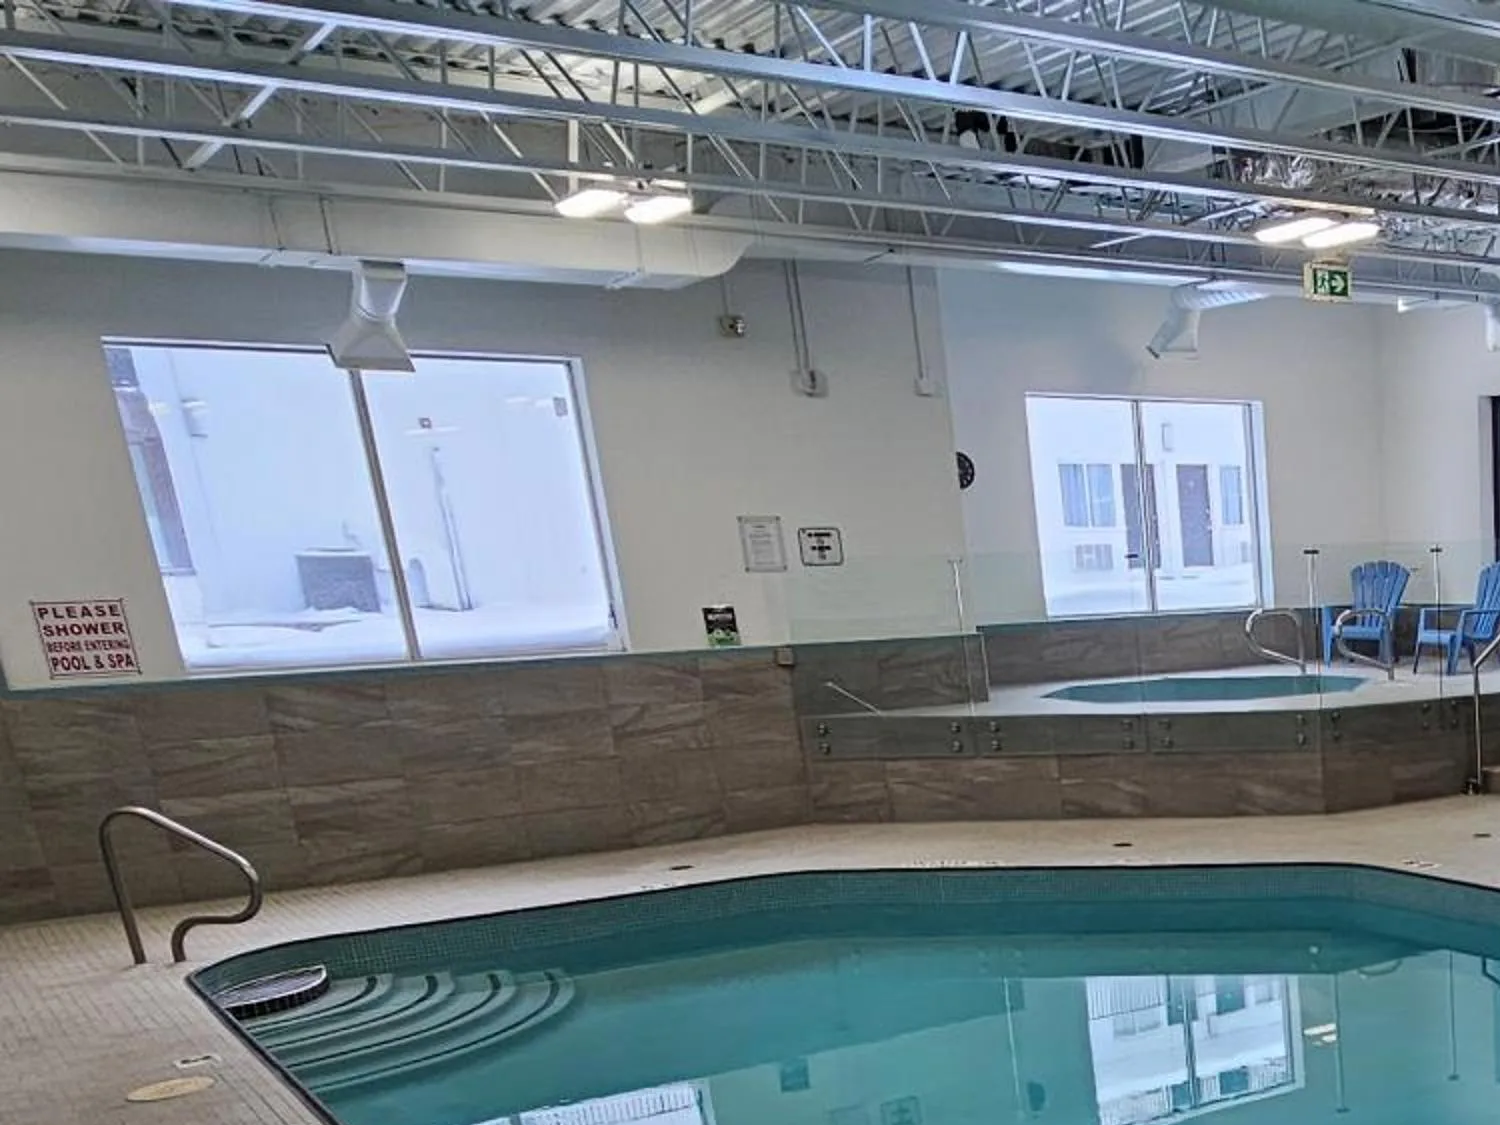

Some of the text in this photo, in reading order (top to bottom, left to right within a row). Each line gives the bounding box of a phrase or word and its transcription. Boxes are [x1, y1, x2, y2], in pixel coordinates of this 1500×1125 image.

[37, 604, 121, 620] PLEASE
[43, 622, 126, 637] SHOWER
[47, 639, 131, 653] BEFORE ENTERING
[52, 653, 135, 672] POOL & SPA
